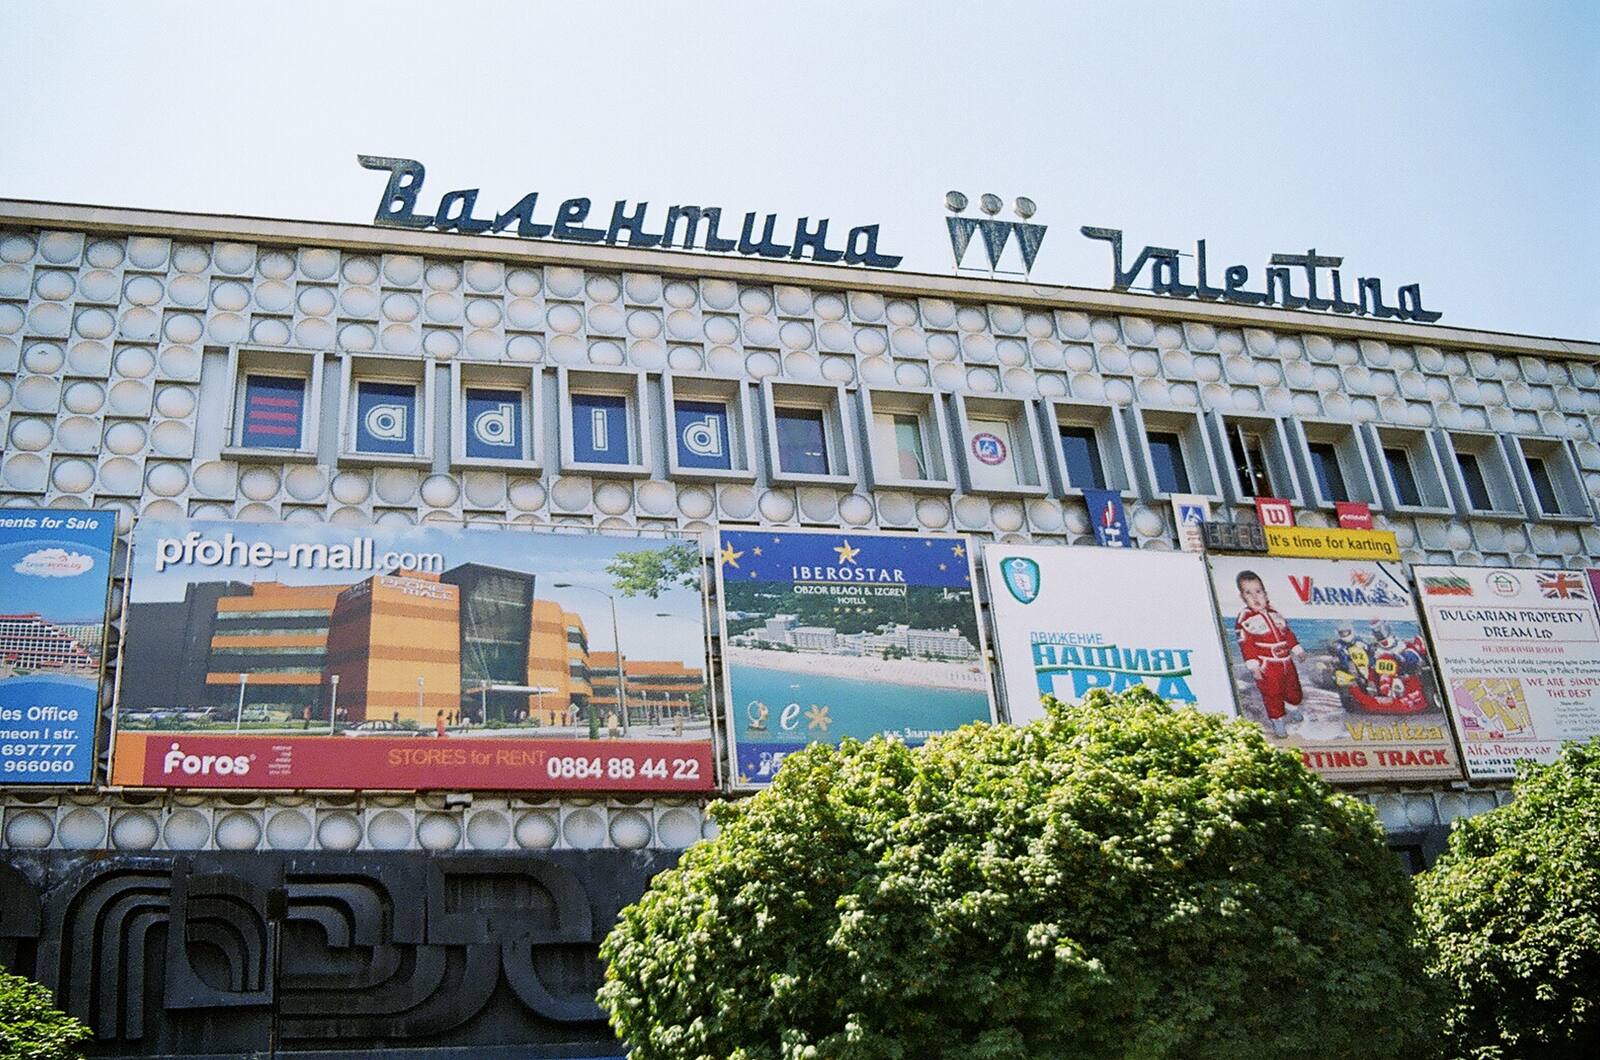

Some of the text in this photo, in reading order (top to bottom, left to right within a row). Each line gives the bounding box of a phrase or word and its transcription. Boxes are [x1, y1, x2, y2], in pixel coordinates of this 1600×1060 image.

[357, 153, 903, 269] Валентина
[1080, 225, 1443, 324] Valentina
[40, 516, 64, 529] for
[65, 517, 99, 530] Sale
[156, 531, 444, 572] pfohe-mall.com
[1269, 534, 1392, 554] It's time for karting
[792, 566, 905, 582] IBEROSTAR
[793, 585, 907, 597] OBZOR BEACH & IZGREV
[1288, 575, 1368, 605] VARNA
[1439, 609, 1584, 623] BULGARIAN PROPERTY
[1030, 631, 1104, 645] ДВИЖЕНИЕ
[1483, 626, 1533, 638] DREAM
[1031, 643, 1193, 671] НАШИЯТ
[1526, 677, 1544, 686] WE
[1547, 677, 1567, 687] ARE
[1546, 688, 1592, 698] THE BEST
[27, 705, 79, 721] Office
[53, 728, 79, 740] str.
[1344, 720, 1444, 741] Vinitza
[1, 744, 77, 757] 697777
[164, 742, 250, 775] foros
[1373, 749, 1450, 767] TRACK
[4, 760, 74, 773] 966060
[388, 748, 700, 780] STORES for RENT 0884 88 44 22
